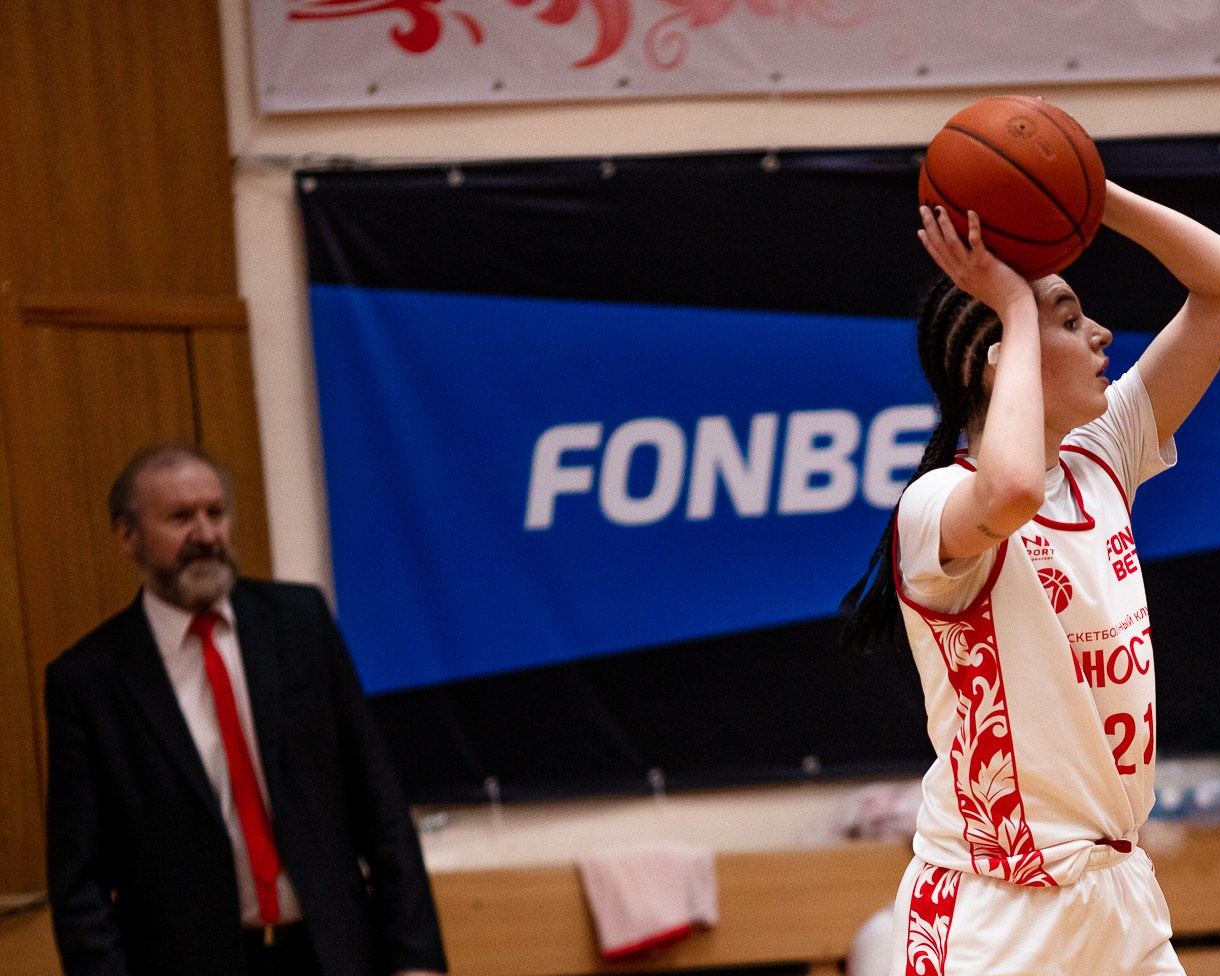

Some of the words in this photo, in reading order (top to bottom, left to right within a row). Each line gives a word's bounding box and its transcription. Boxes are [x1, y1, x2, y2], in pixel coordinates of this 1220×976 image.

[523, 403, 938, 531] FONBE
[1027, 548, 1054, 556] PORT
[1104, 702, 1154, 775] 21
